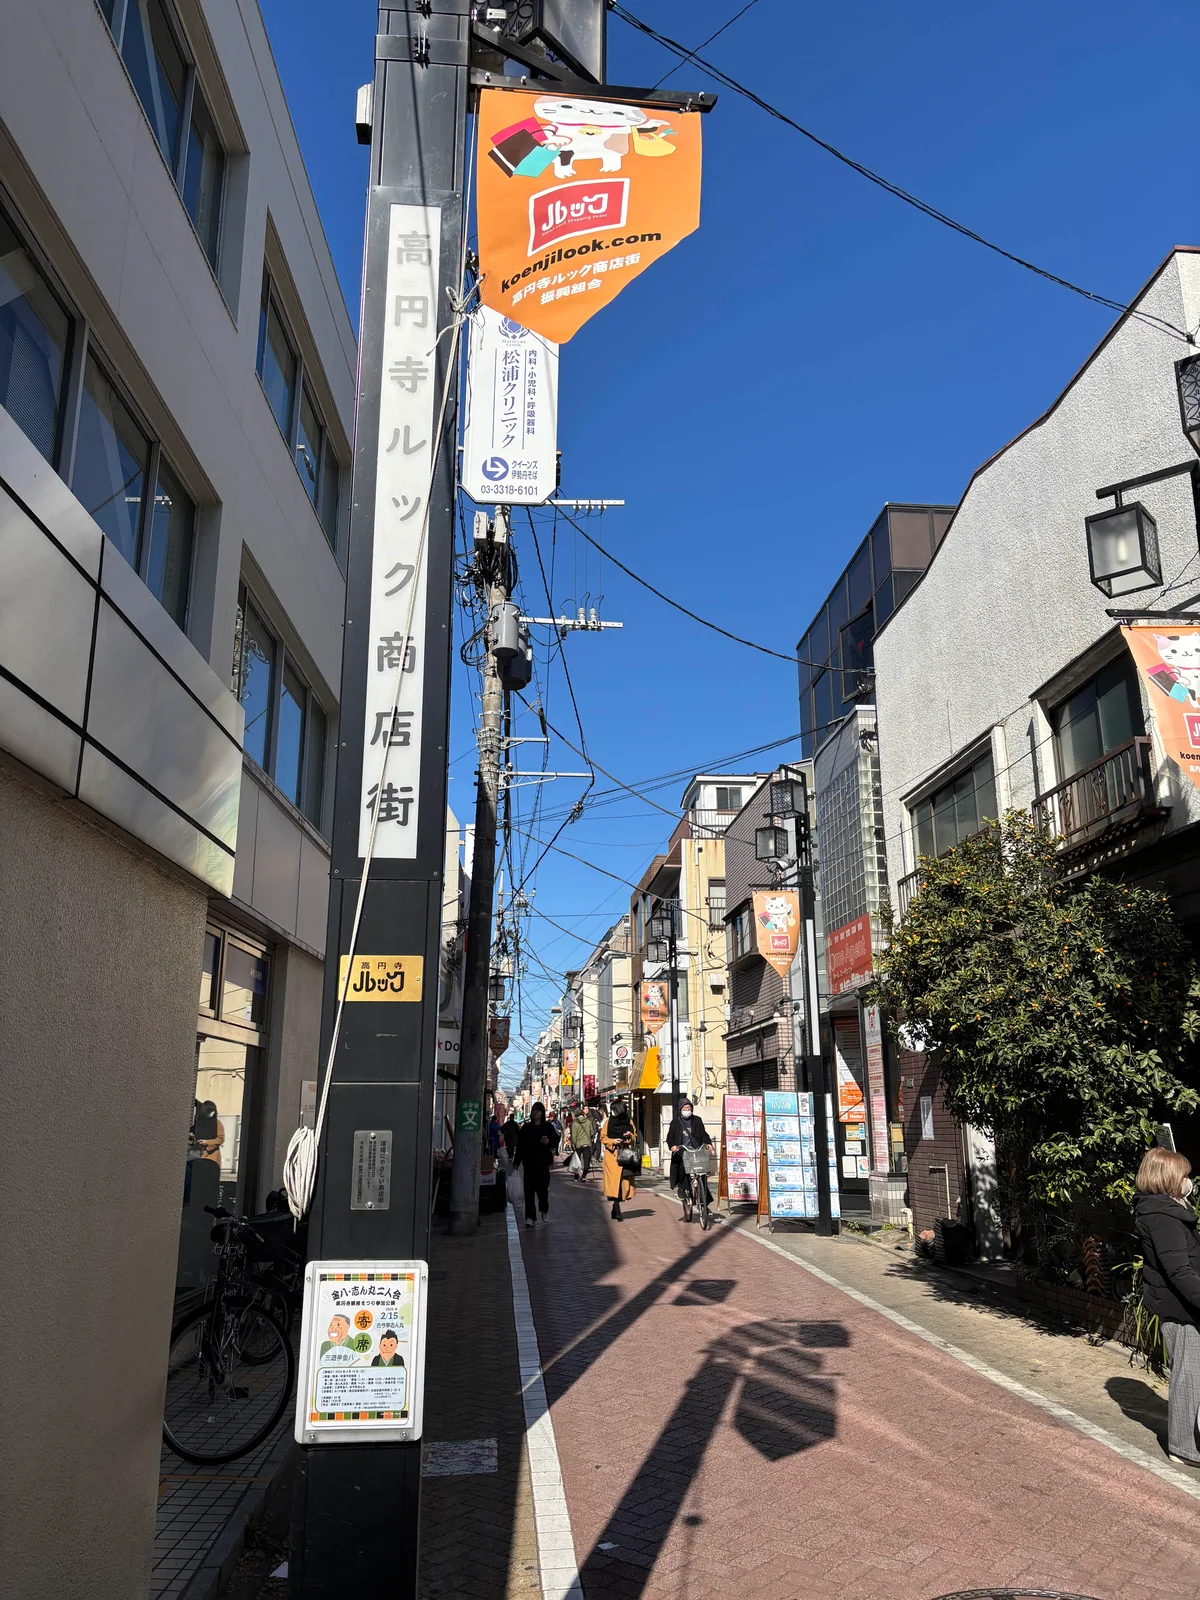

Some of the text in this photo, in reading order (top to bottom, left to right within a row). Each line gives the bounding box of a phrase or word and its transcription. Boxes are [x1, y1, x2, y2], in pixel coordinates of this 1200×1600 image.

[501, 232, 662, 294] koenjilook.com
[511, 252, 641, 306] 高円寺ルック商店街
[540, 278, 602, 305] 振興組合
[500, 349, 521, 449] 松浦クリニック
[526, 349, 537, 435] 内科・小児科・呼吸器科
[511, 460, 538, 469] クイーンズ
[480, 484, 538, 496] 03-3318-6101
[366, 230, 432, 827] 高円寺ルック商店街
[361, 961, 402, 970] 高円寺
[380, 1311, 399, 1320] 2/15
